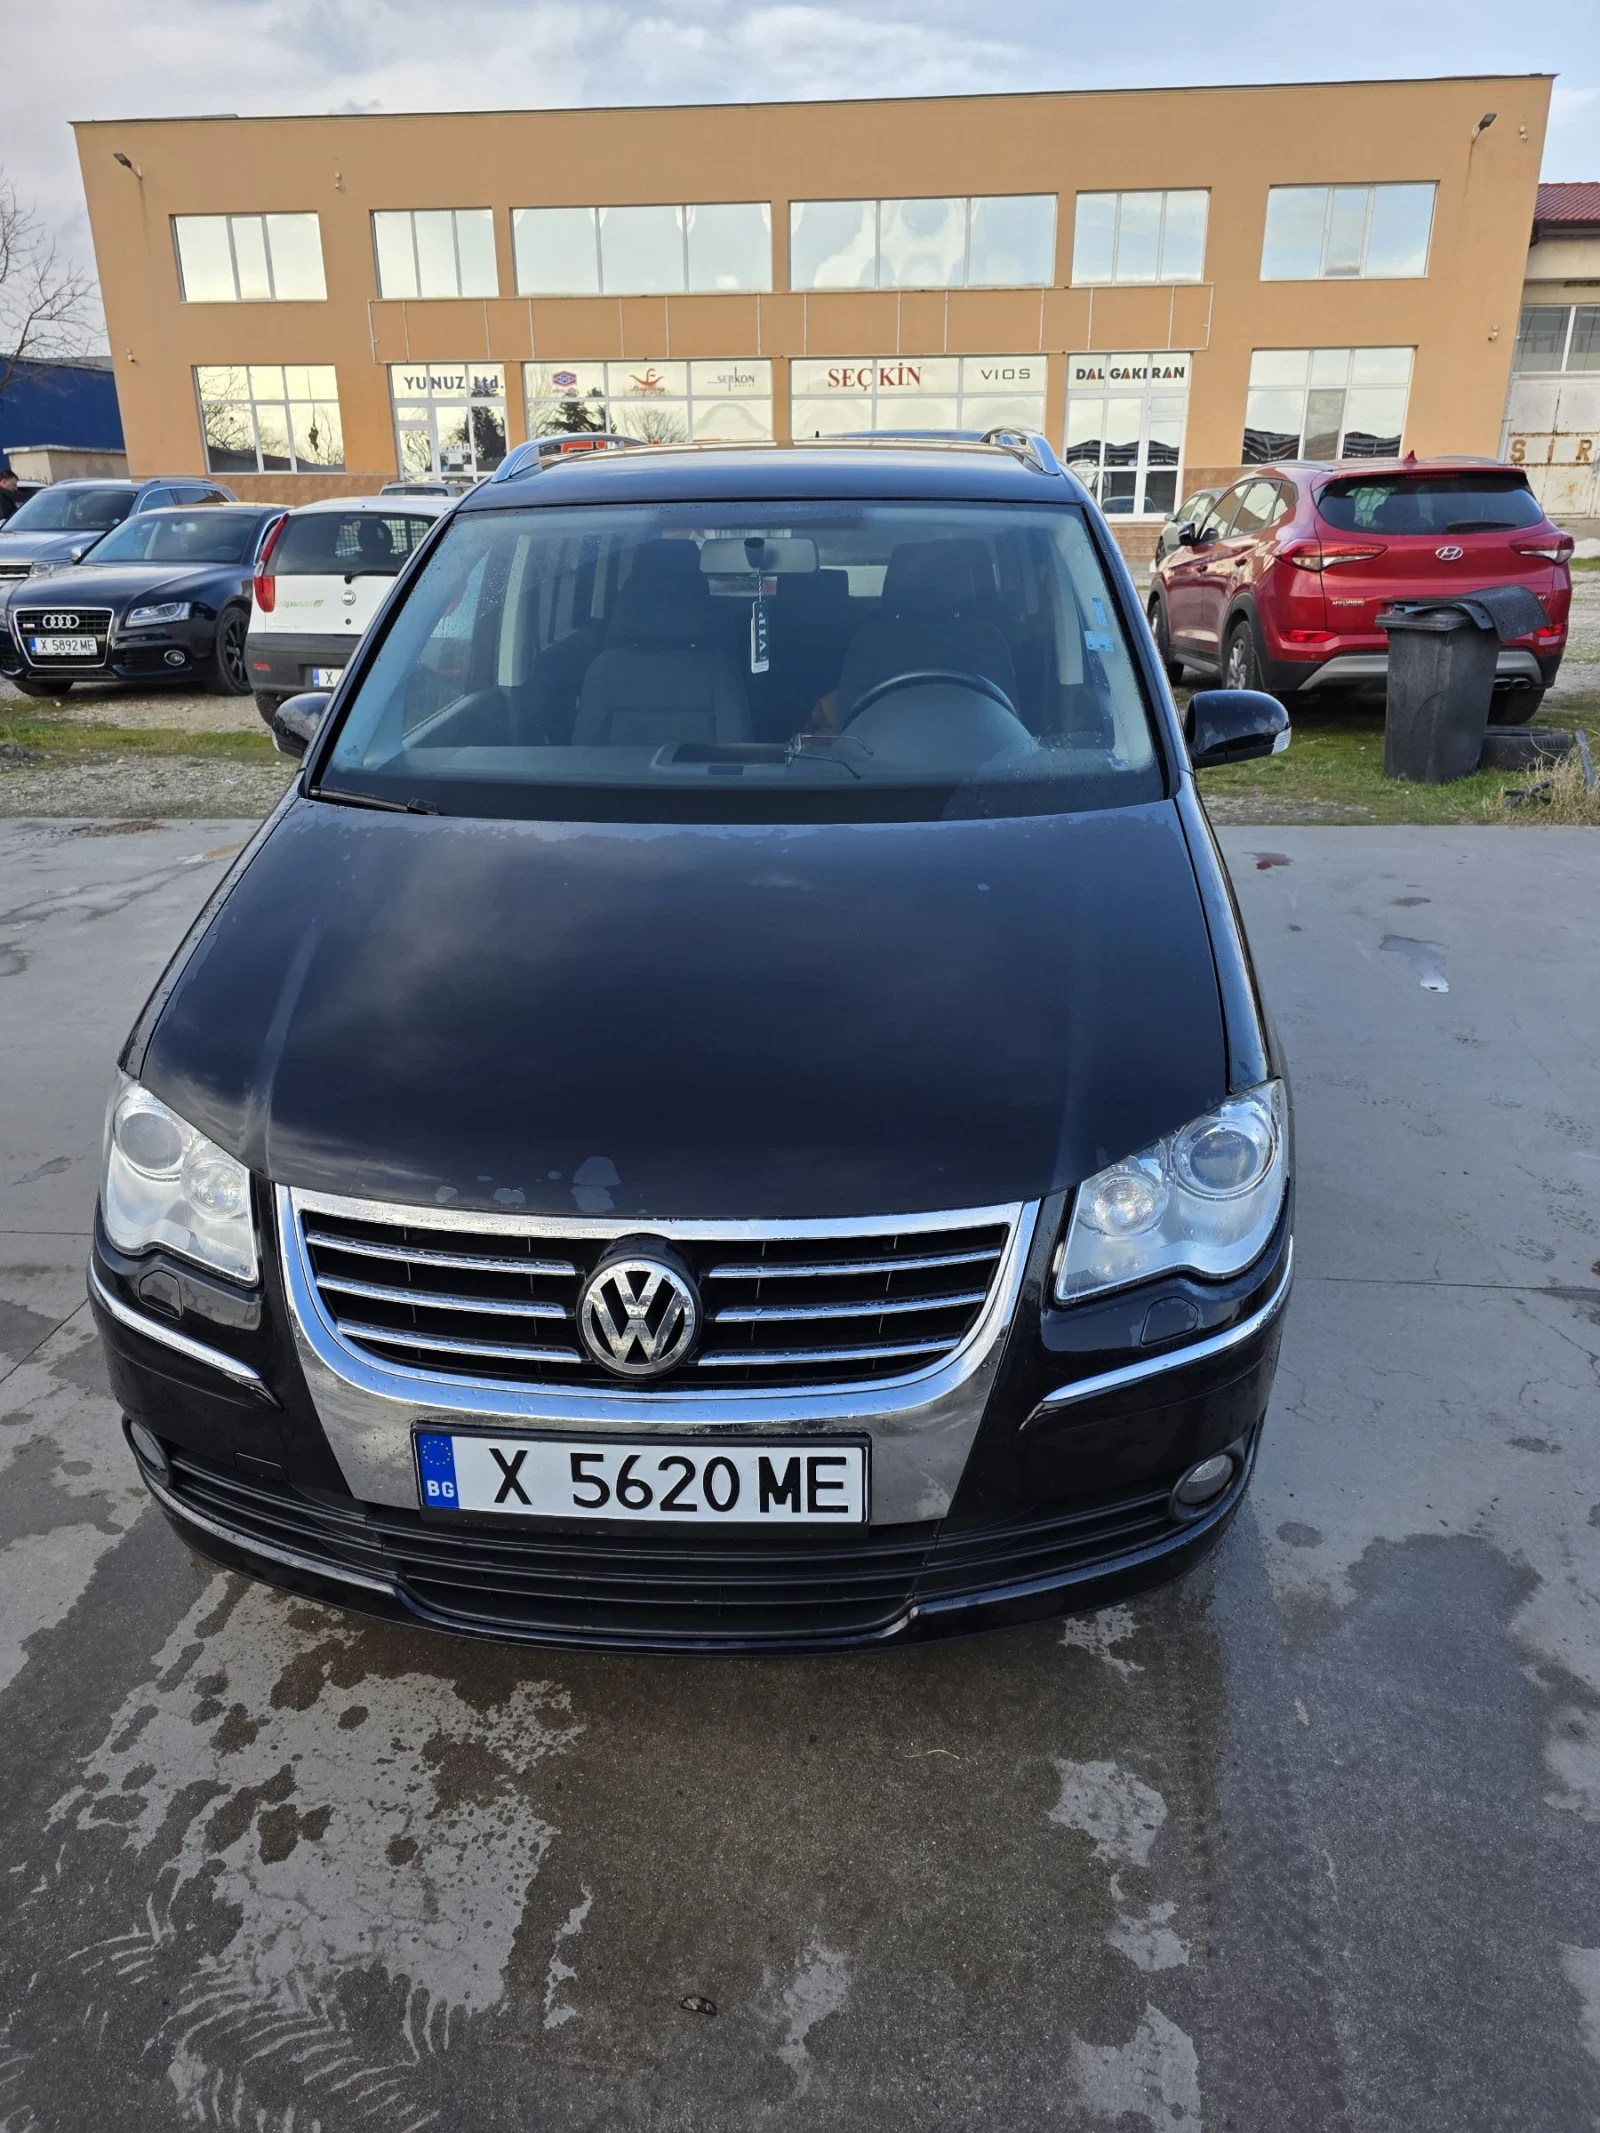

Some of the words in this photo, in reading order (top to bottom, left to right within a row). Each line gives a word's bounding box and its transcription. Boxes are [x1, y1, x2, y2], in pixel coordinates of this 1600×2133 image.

[403, 376, 465, 390] YUNUZ
[828, 362, 922, 391] SEÇKİN
[981, 368, 1031, 381] VIOS
[427, 1479, 455, 1498] BG
[488, 1447, 533, 1506] X
[570, 1452, 741, 1513] 5620
[757, 1455, 849, 1514] ME
